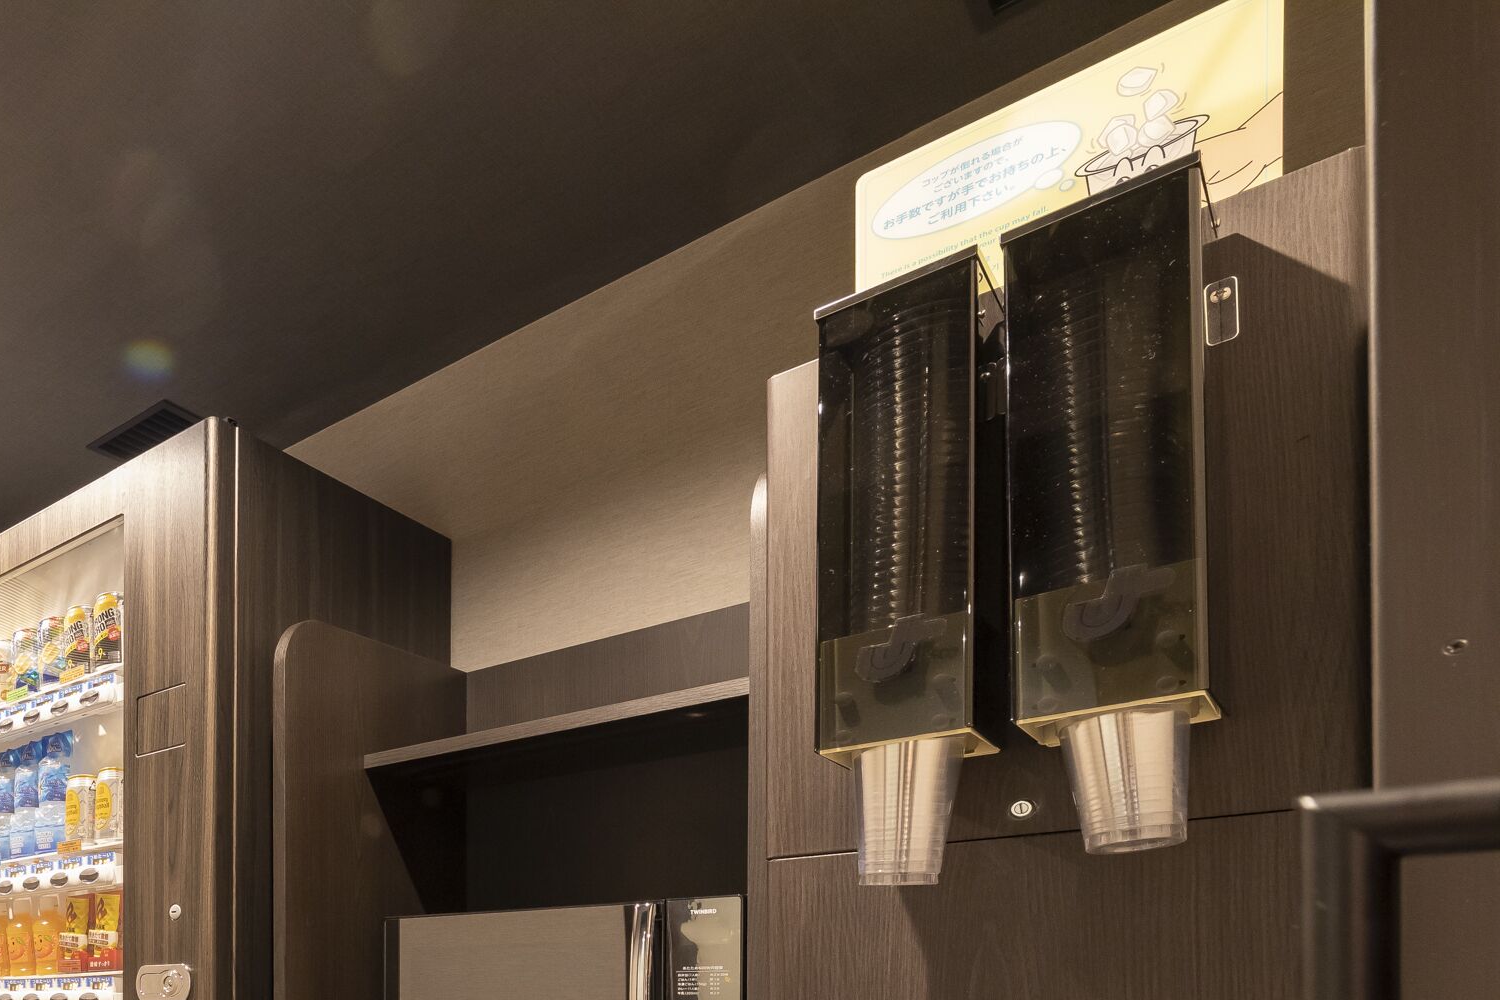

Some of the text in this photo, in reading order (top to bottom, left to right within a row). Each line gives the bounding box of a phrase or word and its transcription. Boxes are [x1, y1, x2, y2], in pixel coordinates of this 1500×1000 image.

[922, 136, 1024, 187] コップが倒れる場合が
[934, 157, 1010, 193] ございますので、
[883, 146, 1067, 230] お手数ですが手でお持ちの上、
[928, 184, 1015, 225] ご利用下さい。
[881, 264, 904, 280] There
[918, 241, 959, 265] possibility
[960, 235, 977, 247] that
[979, 229, 993, 240] the
[994, 222, 1011, 235] cup
[1011, 213, 1031, 229] may
[1032, 206, 1050, 218] fall.
